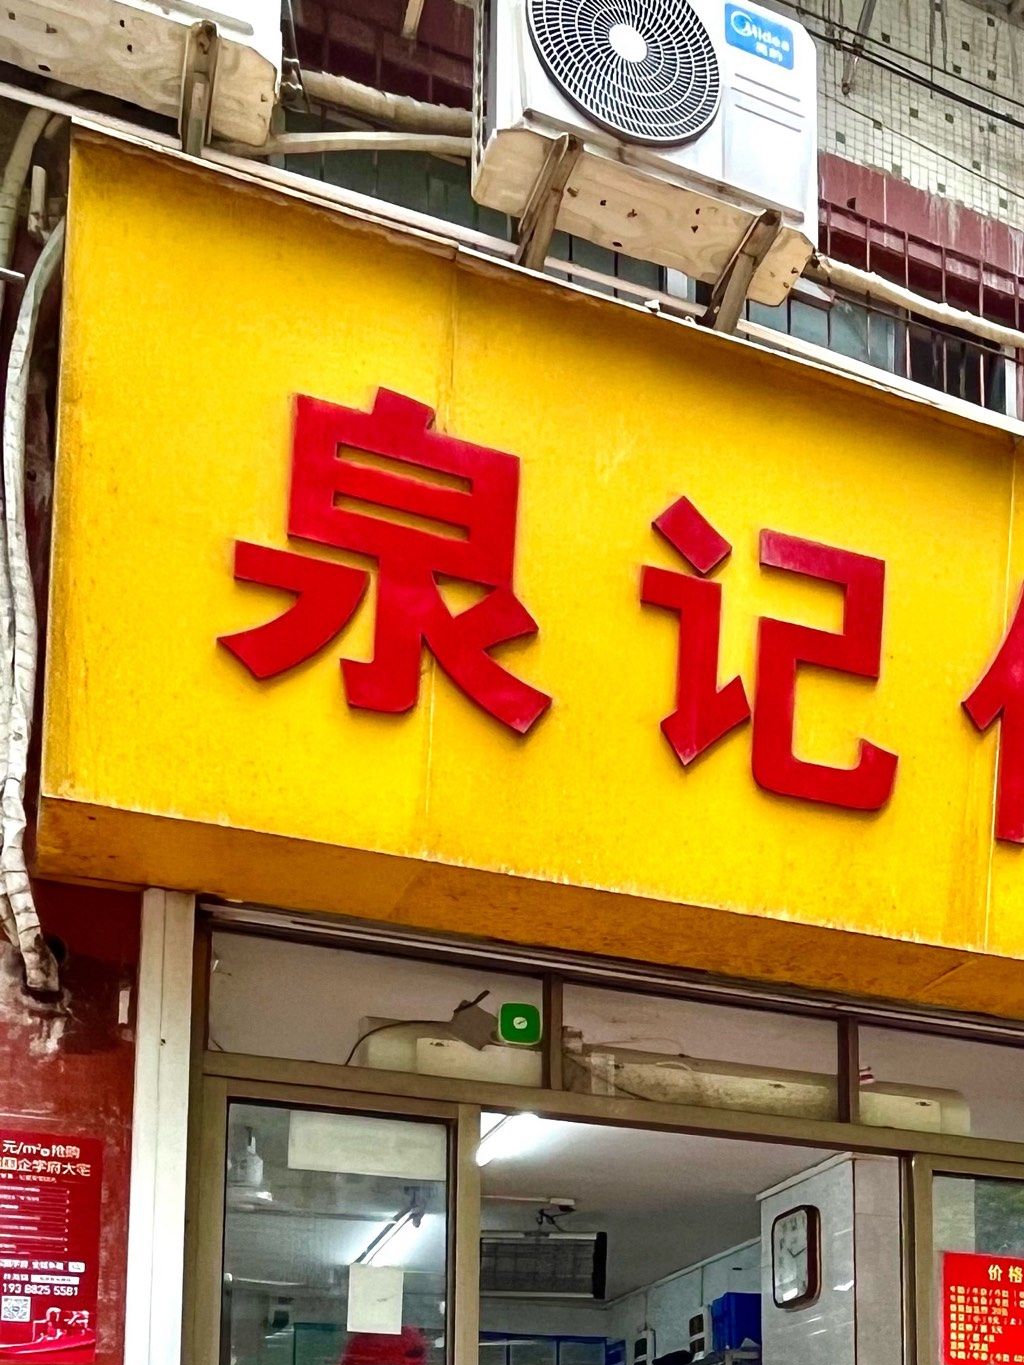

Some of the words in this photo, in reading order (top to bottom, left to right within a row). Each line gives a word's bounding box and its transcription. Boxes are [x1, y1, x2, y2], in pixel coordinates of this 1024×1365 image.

[0, 1156, 91, 1176] 国企学府大宅
[3, 1283, 22, 1294] 193
